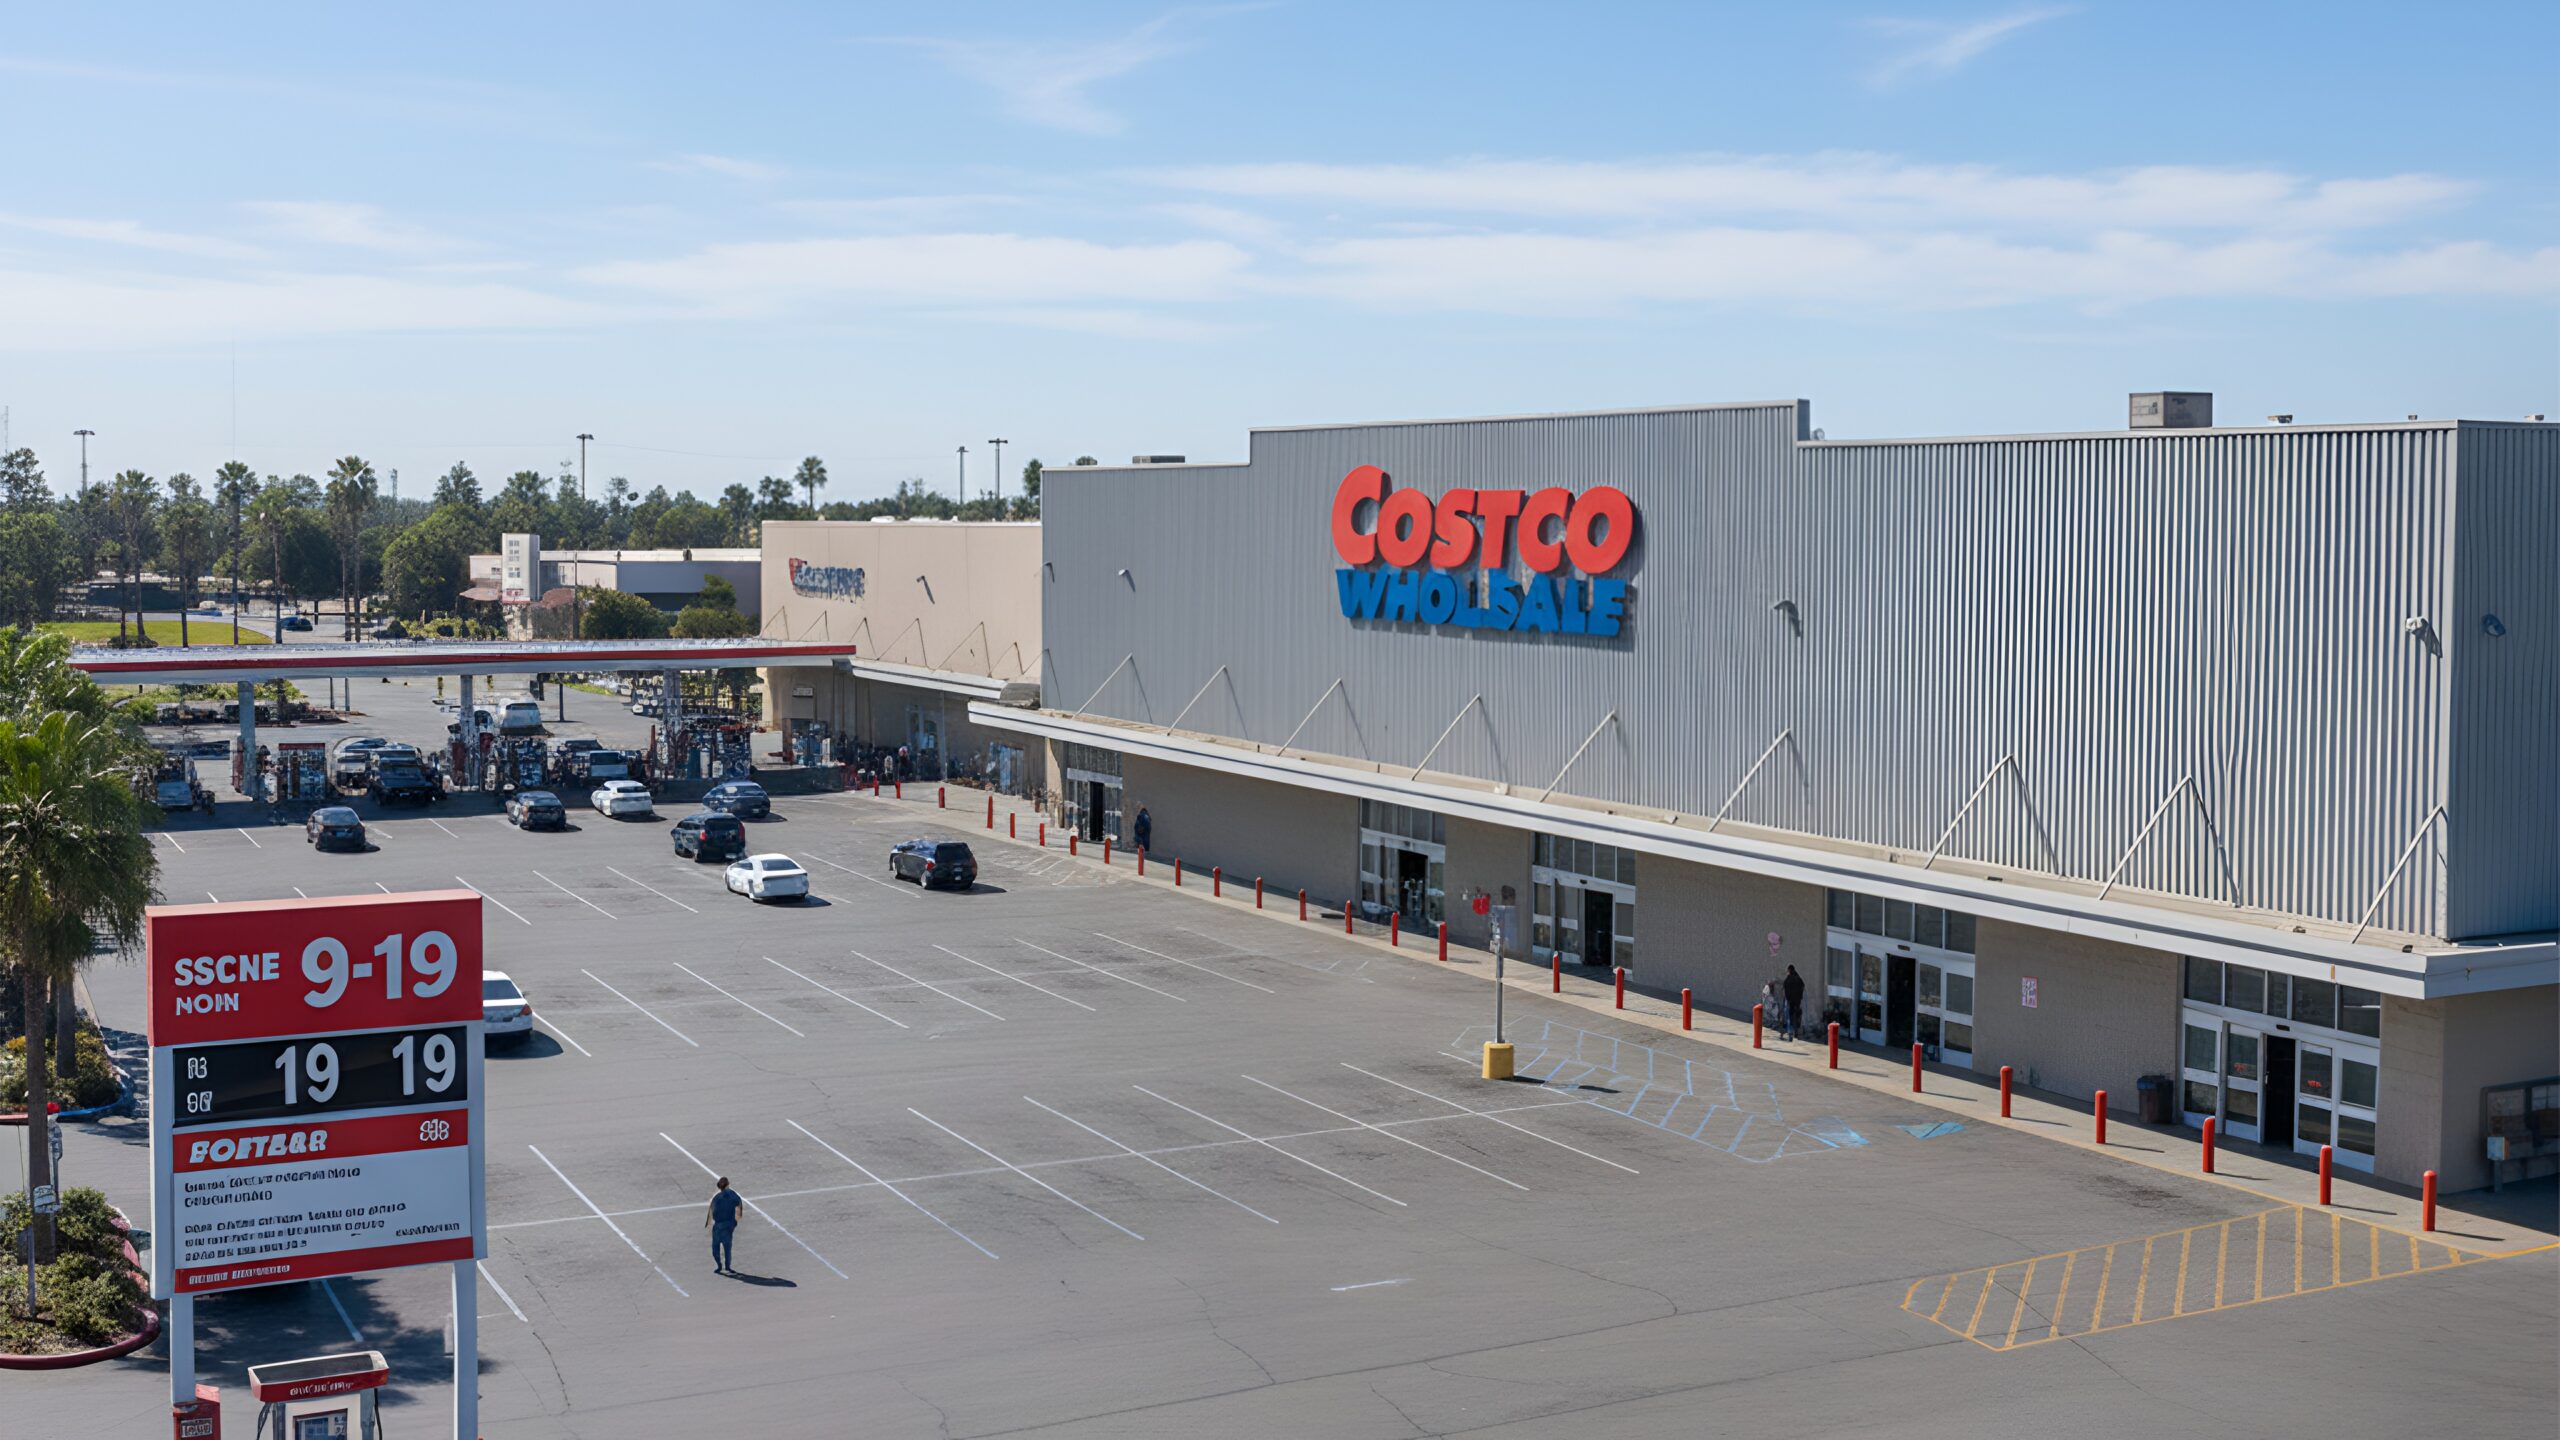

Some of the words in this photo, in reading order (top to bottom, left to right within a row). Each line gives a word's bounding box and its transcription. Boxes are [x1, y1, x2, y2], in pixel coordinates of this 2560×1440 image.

[1331, 464, 1633, 574] COSTCO
[174, 951, 280, 987] SSCNE
[301, 930, 458, 1008] 9-19
[274, 1042, 340, 1105] 19
[392, 1033, 456, 1096] 19
